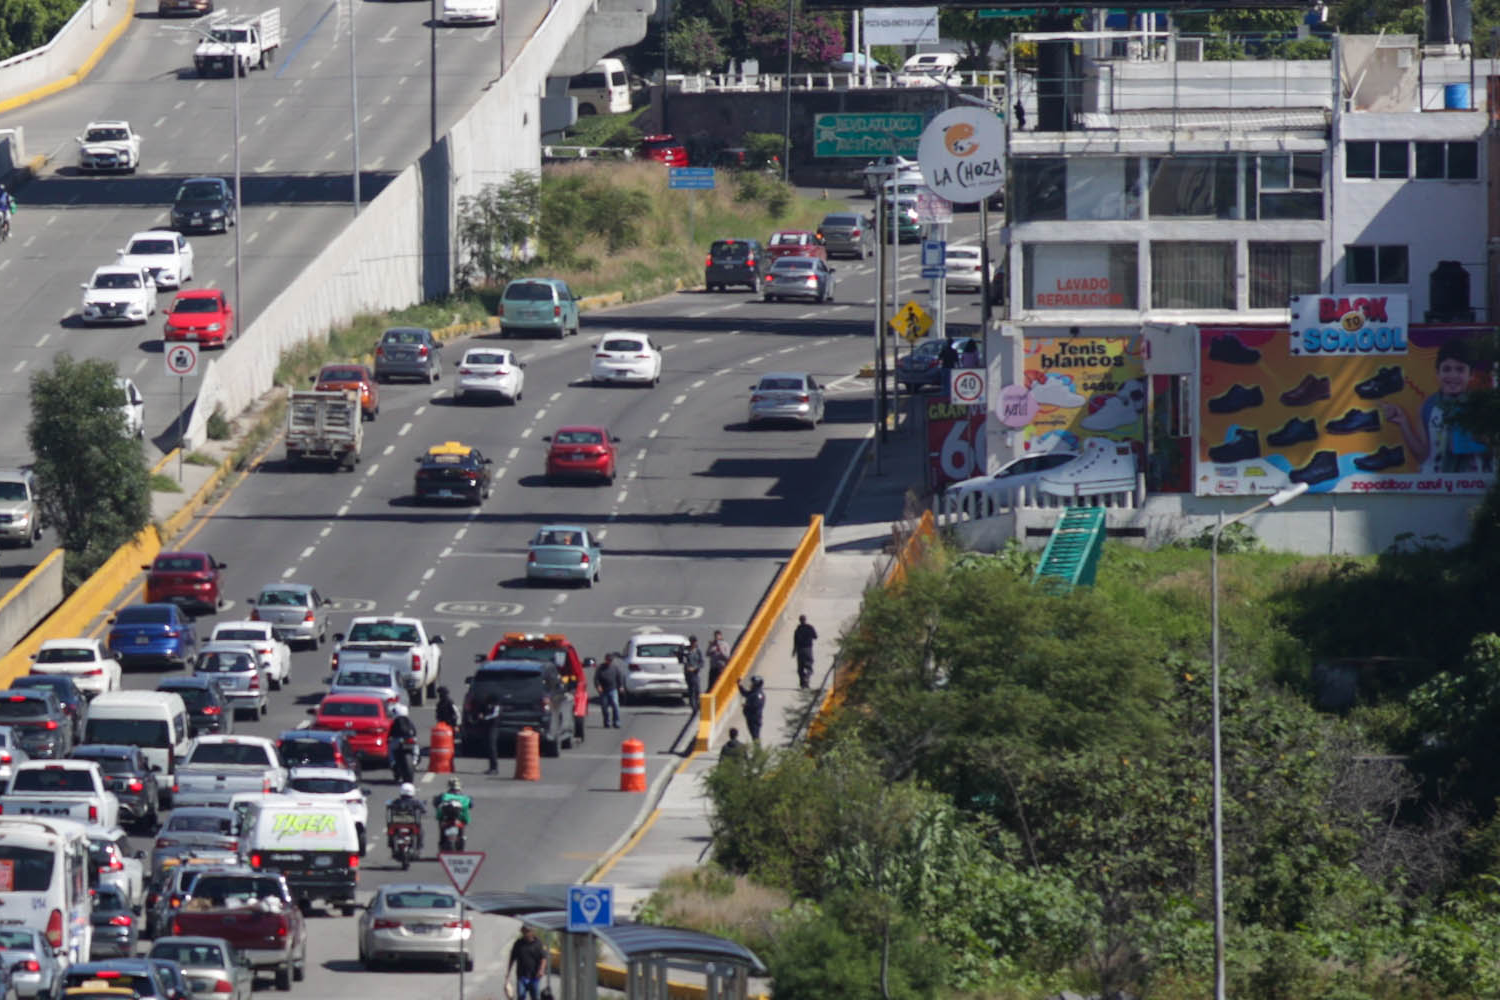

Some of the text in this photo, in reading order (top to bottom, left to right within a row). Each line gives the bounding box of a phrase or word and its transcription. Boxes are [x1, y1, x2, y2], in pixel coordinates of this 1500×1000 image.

[934, 167, 952, 186] LA
[1057, 278, 1110, 291] LAVADO
[1318, 297, 1388, 323] BACK
[1344, 317, 1360, 328] TO
[1303, 328, 1407, 352] SCHOOL
[1059, 342, 1107, 355] Tenis
[1041, 354, 1125, 369] blancos
[960, 377, 976, 390] 40
[20, 807, 70, 815] RAM
[272, 814, 337, 834] TIGER
